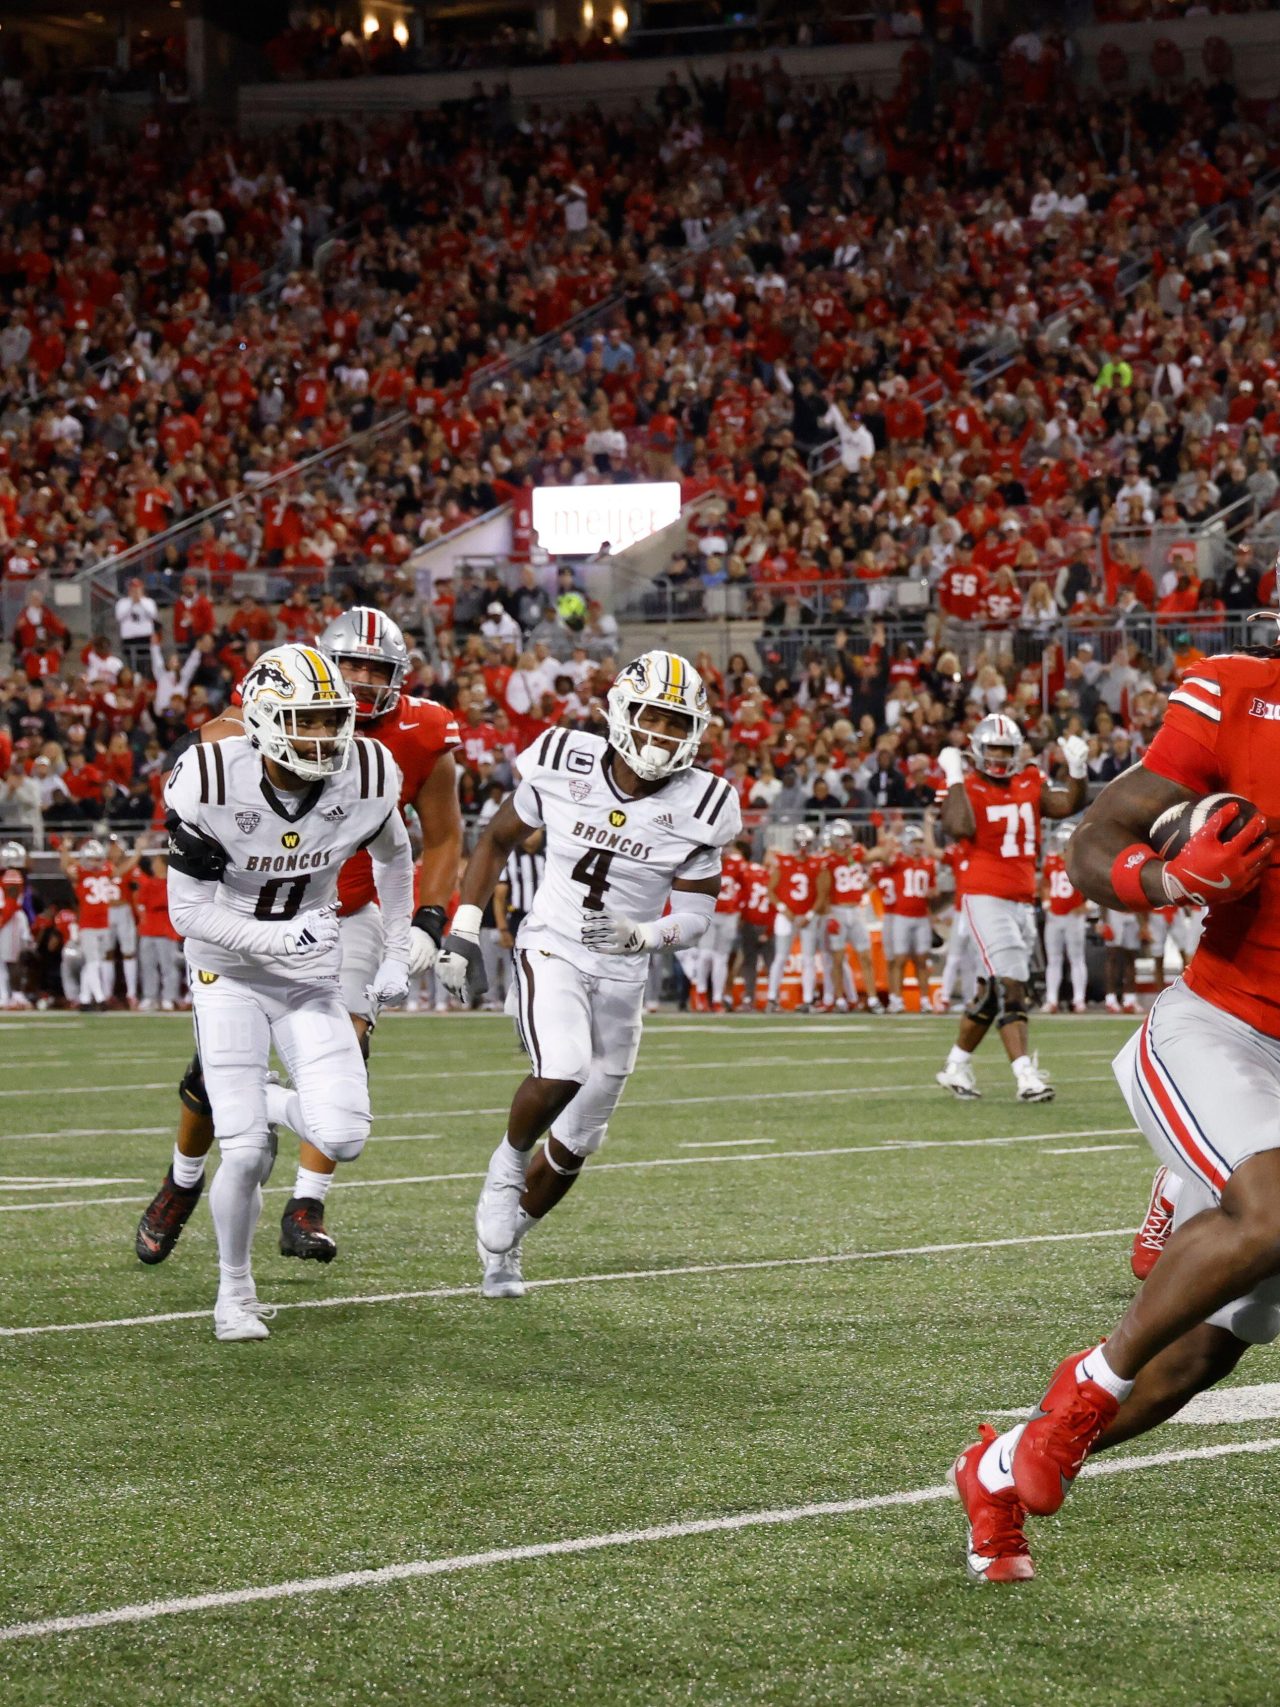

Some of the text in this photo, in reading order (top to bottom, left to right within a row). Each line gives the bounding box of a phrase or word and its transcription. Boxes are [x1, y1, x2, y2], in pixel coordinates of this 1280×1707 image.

[284, 835, 298, 847] W
[572, 821, 652, 860] BRONCOS
[986, 801, 1036, 858] 71
[246, 849, 332, 872] BRONCOS
[571, 847, 615, 911] 4
[790, 873, 809, 901] 3
[903, 868, 929, 897] 10
[254, 874, 311, 921] 0
